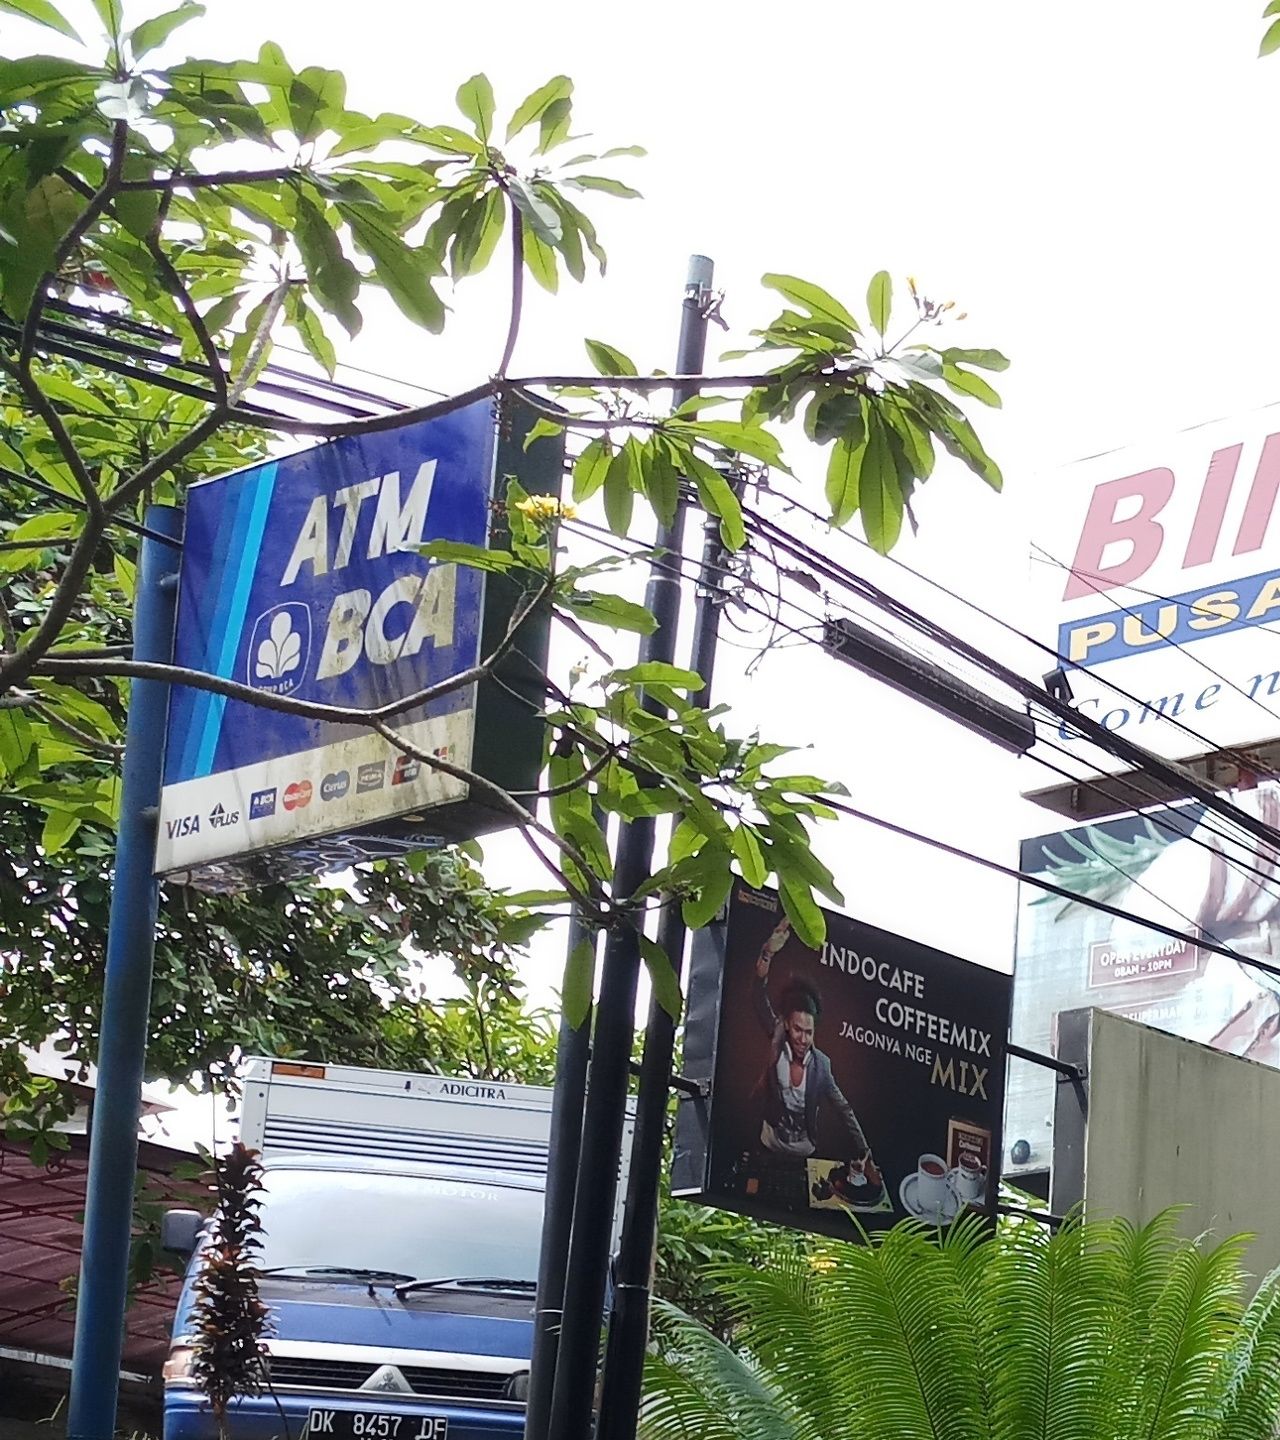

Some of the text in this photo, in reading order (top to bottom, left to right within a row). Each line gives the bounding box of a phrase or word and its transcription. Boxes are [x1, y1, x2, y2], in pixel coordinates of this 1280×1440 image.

[280, 459, 438, 586] ATM
[316, 559, 457, 681] BCA
[166, 814, 200, 839] VISA
[1100, 940, 1187, 967] OPEN EVERYDAY
[1114, 964, 1139, 978] 08AM
[1148, 959, 1172, 972] 10PM
[820, 942, 926, 999] INDOCAFE
[839, 1020, 902, 1056] JAGONYA
[875, 998, 992, 1058] COFFEEMIX
[440, 1083, 506, 1100] ADICITRA
[310, 1410, 446, 1440] DK 8457 DF
